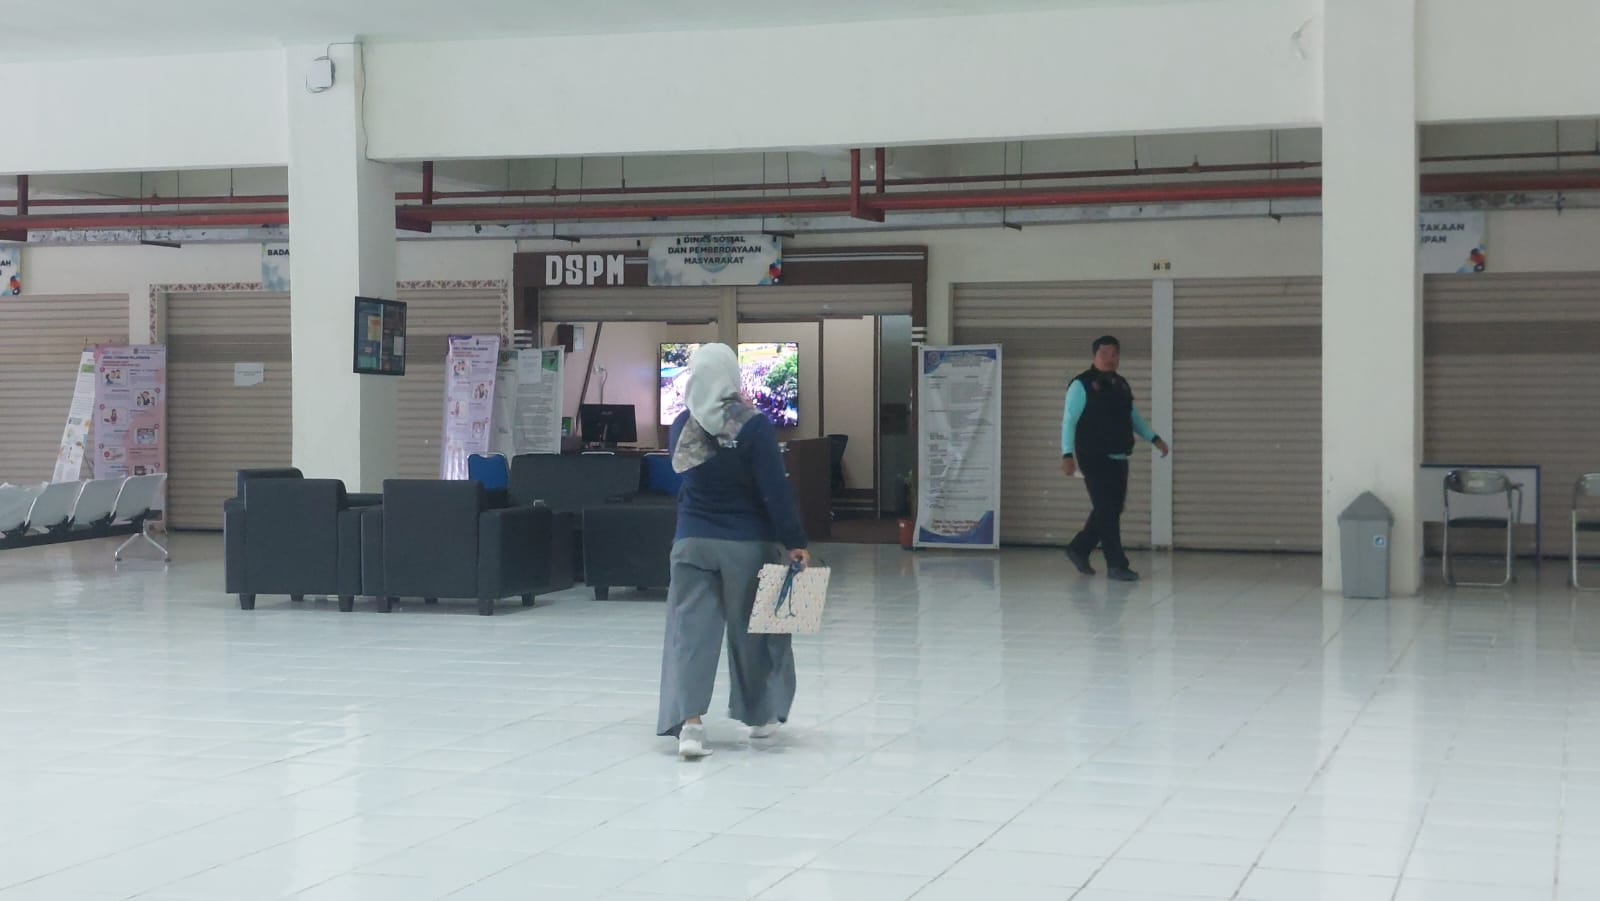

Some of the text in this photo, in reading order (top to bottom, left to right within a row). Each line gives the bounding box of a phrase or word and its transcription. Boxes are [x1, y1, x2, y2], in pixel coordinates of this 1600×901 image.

[684, 236, 711, 244] DINAS
[688, 246, 761, 254] PEMBERDAYAAN
[545, 254, 624, 285] DSPM
